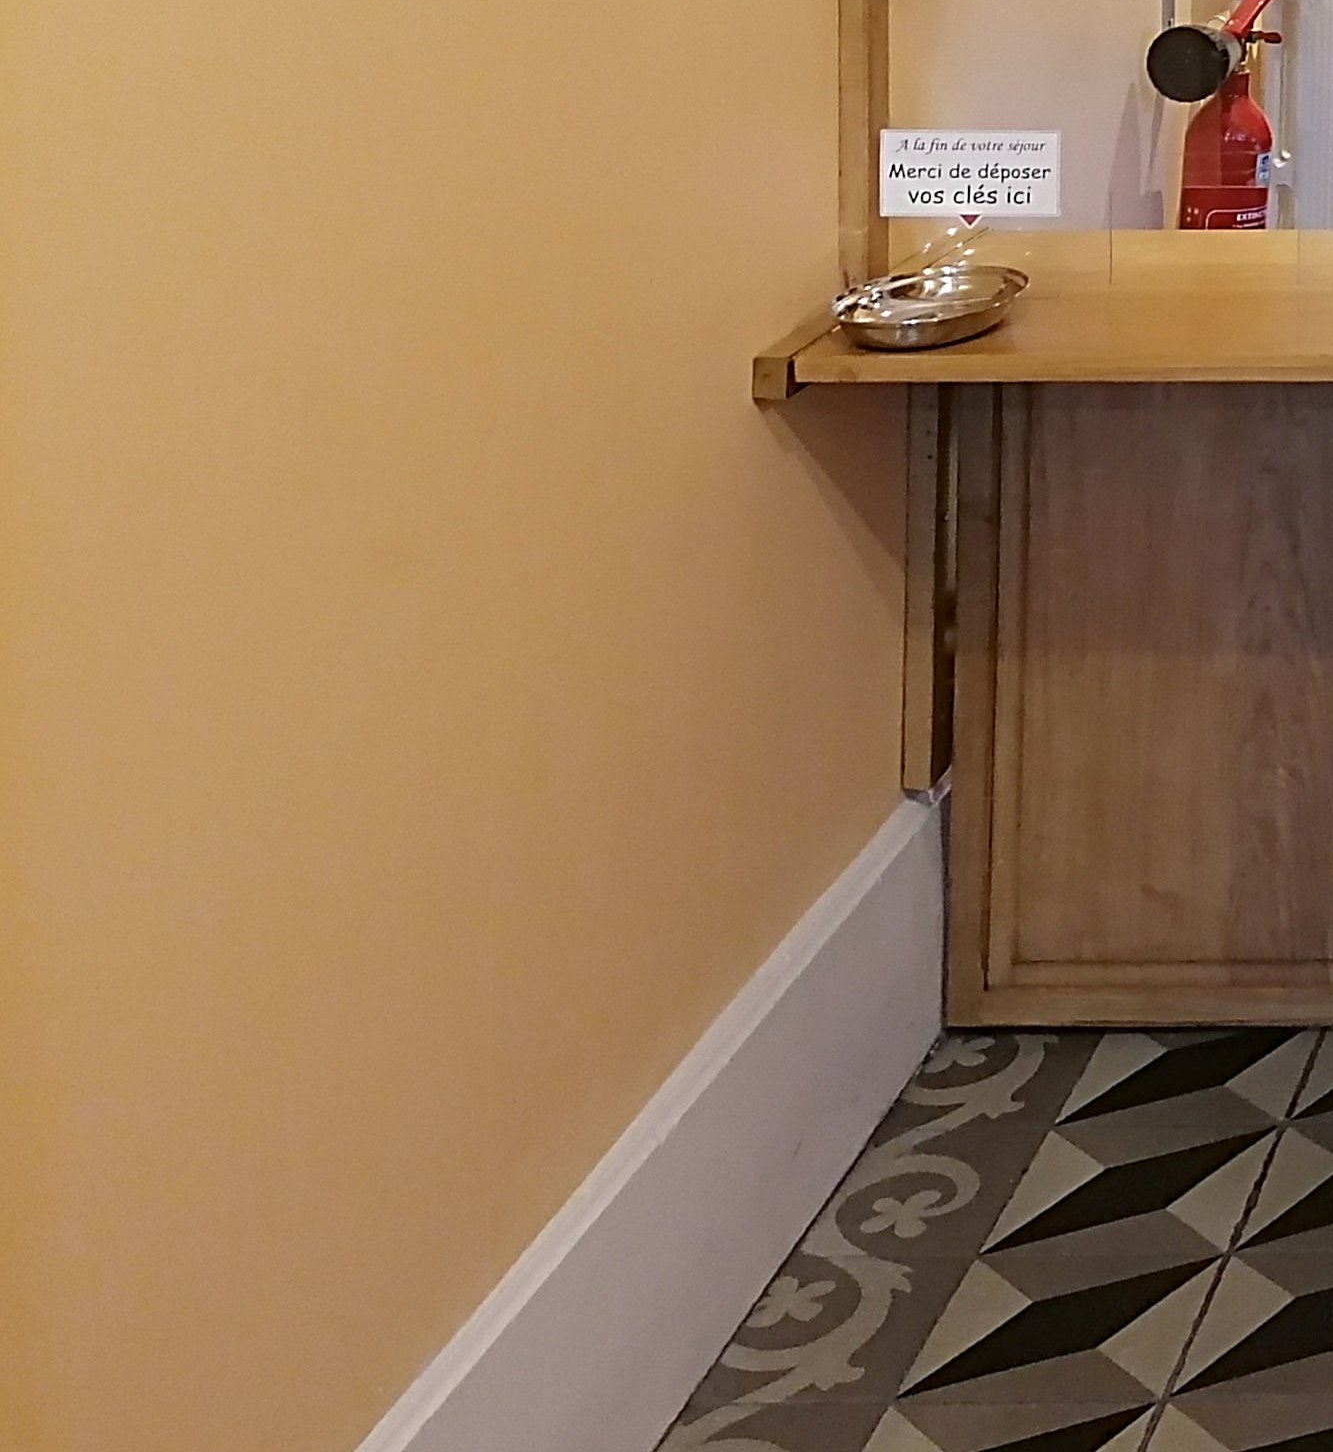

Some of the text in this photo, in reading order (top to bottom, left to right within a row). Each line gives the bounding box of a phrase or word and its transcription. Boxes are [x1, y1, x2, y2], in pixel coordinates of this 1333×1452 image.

[895, 138, 1047, 155] A la fin de votre séjour
[889, 162, 1051, 183] Merci de déposer
[908, 184, 1032, 204] vos clés ici
